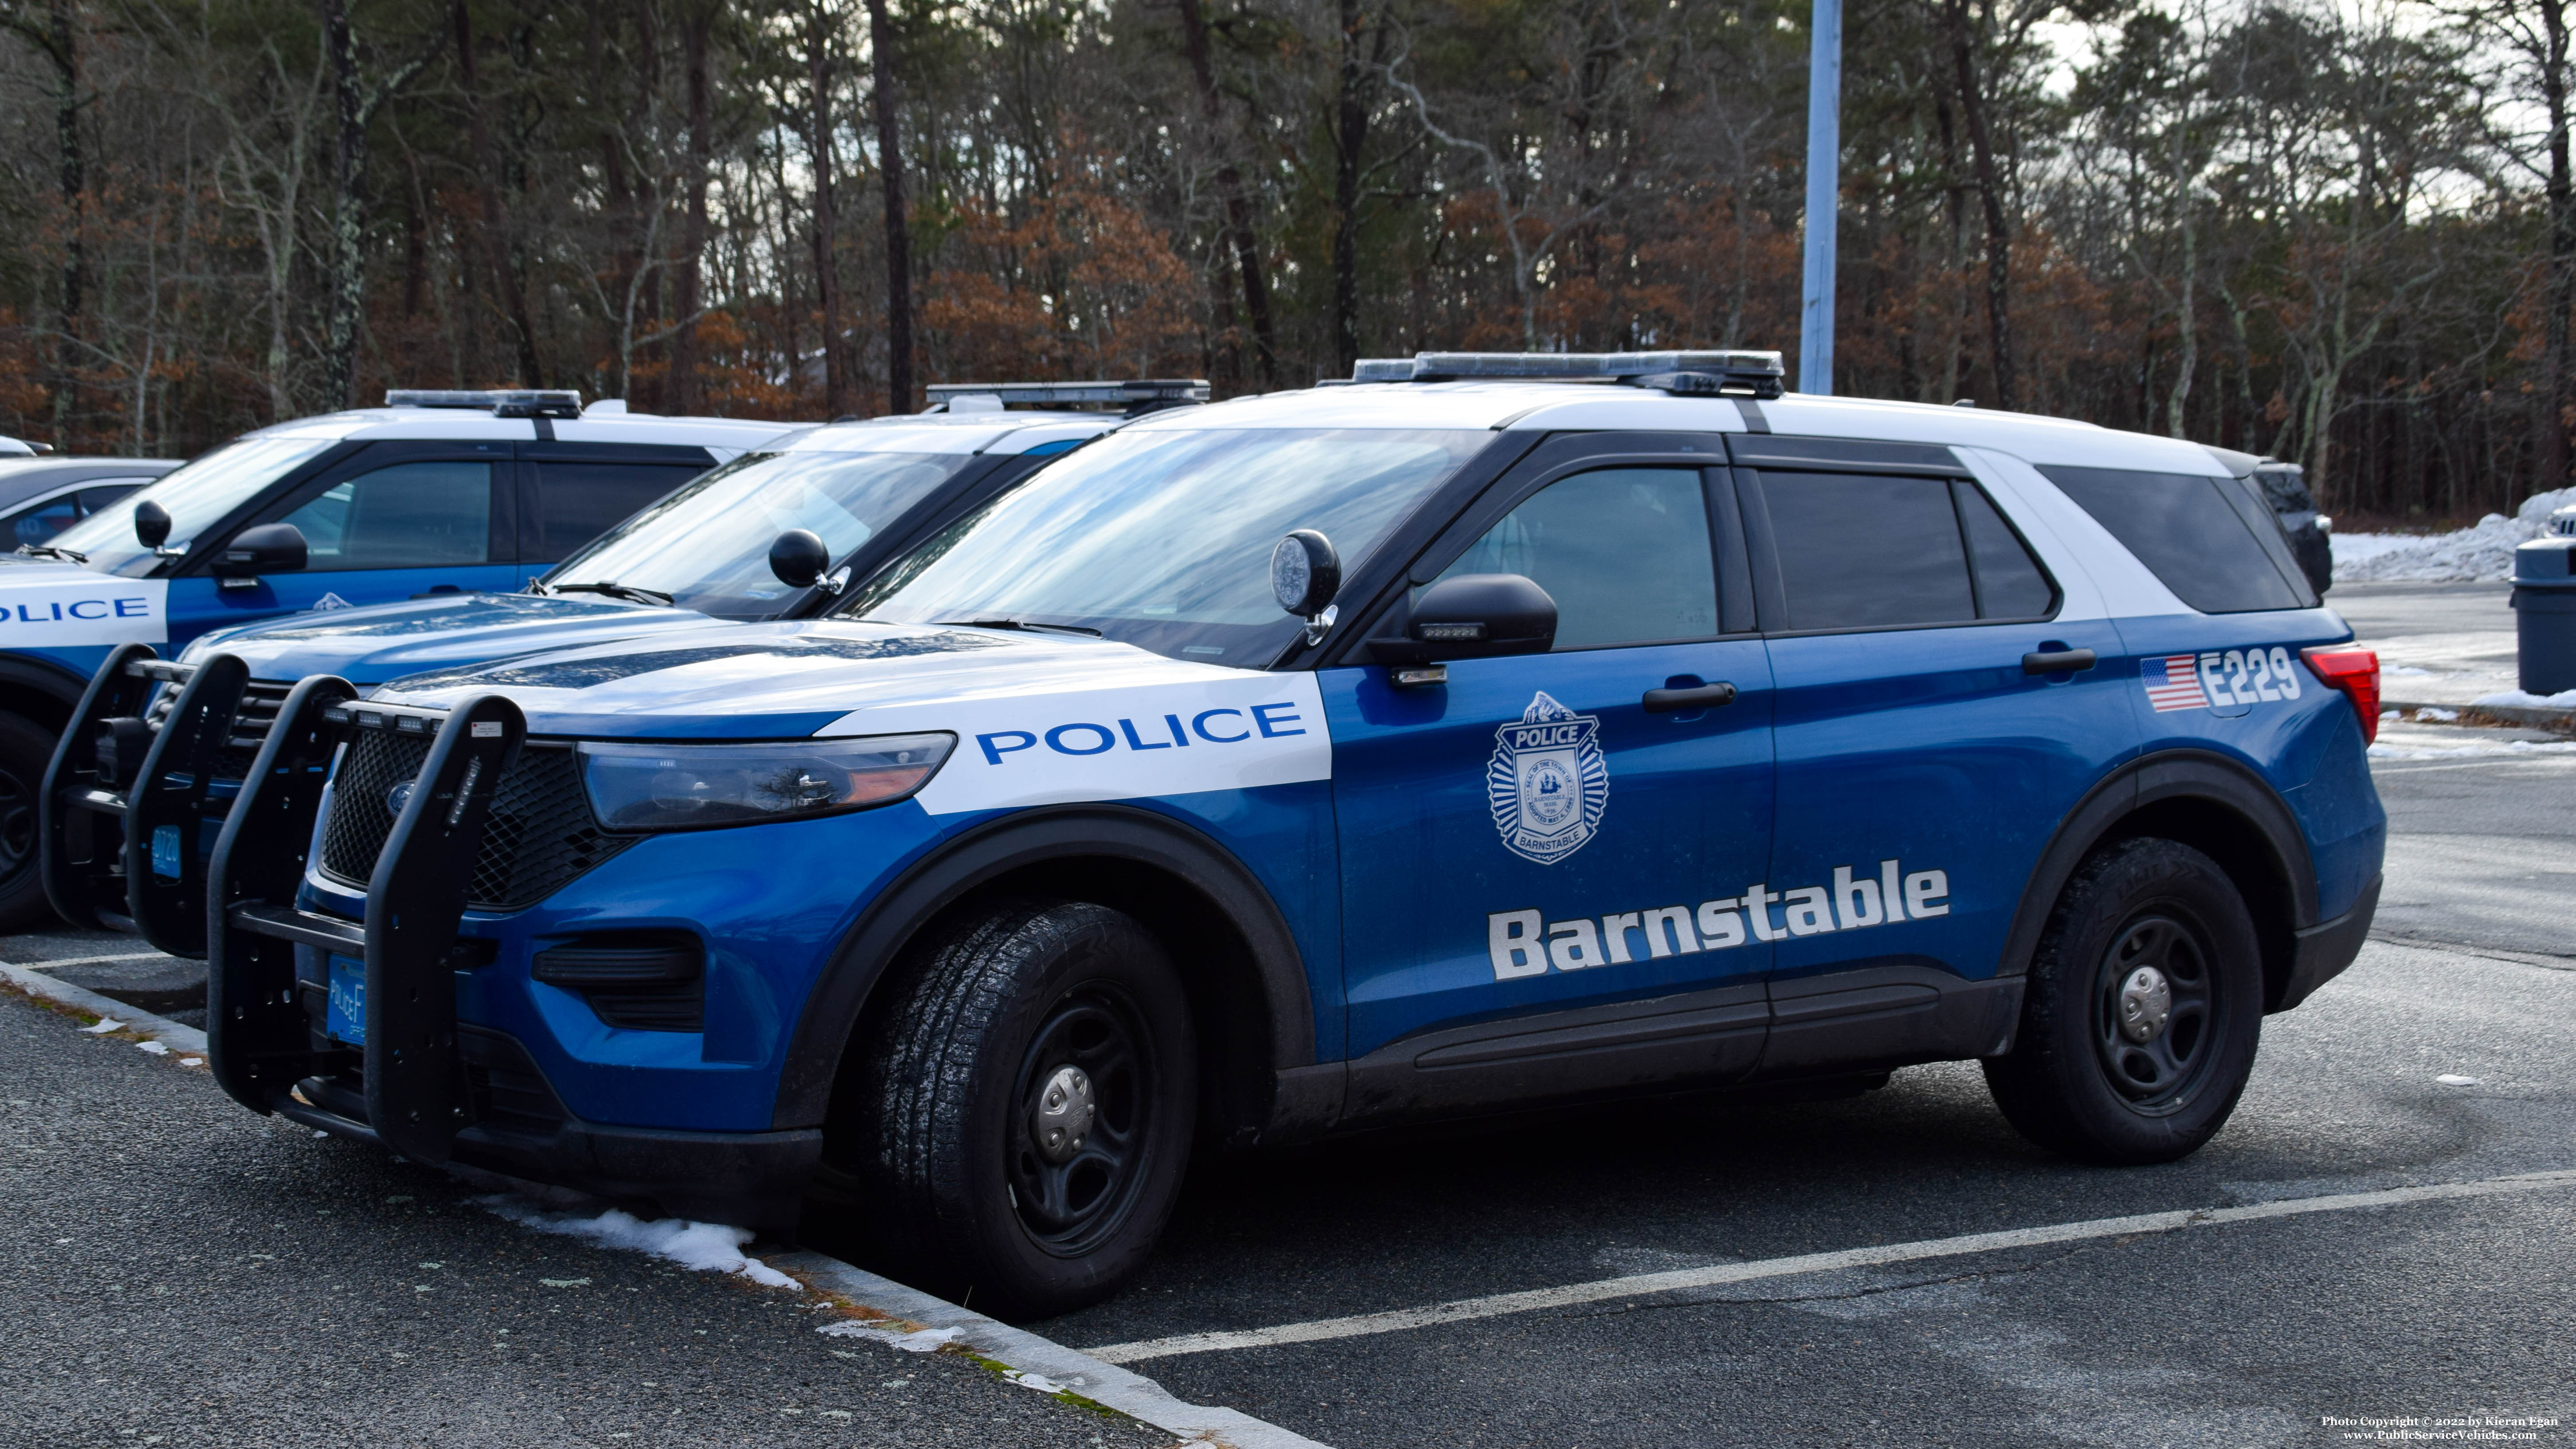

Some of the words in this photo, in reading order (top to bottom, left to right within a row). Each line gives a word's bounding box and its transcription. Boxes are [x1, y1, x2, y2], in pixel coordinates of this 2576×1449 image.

[0, 598, 149, 622] LICE
[2201, 647, 2301, 707] E229
[975, 701, 1306, 766] POLICE
[1515, 726, 1578, 748] POLICE
[1551, 762, 1566, 775] TOWN
[1528, 802, 1547, 823] ADOPTED
[1519, 831, 1580, 851] BARNSTABLE
[1487, 859, 1950, 980] Barnstable
[330, 979, 353, 1021] POLICE
